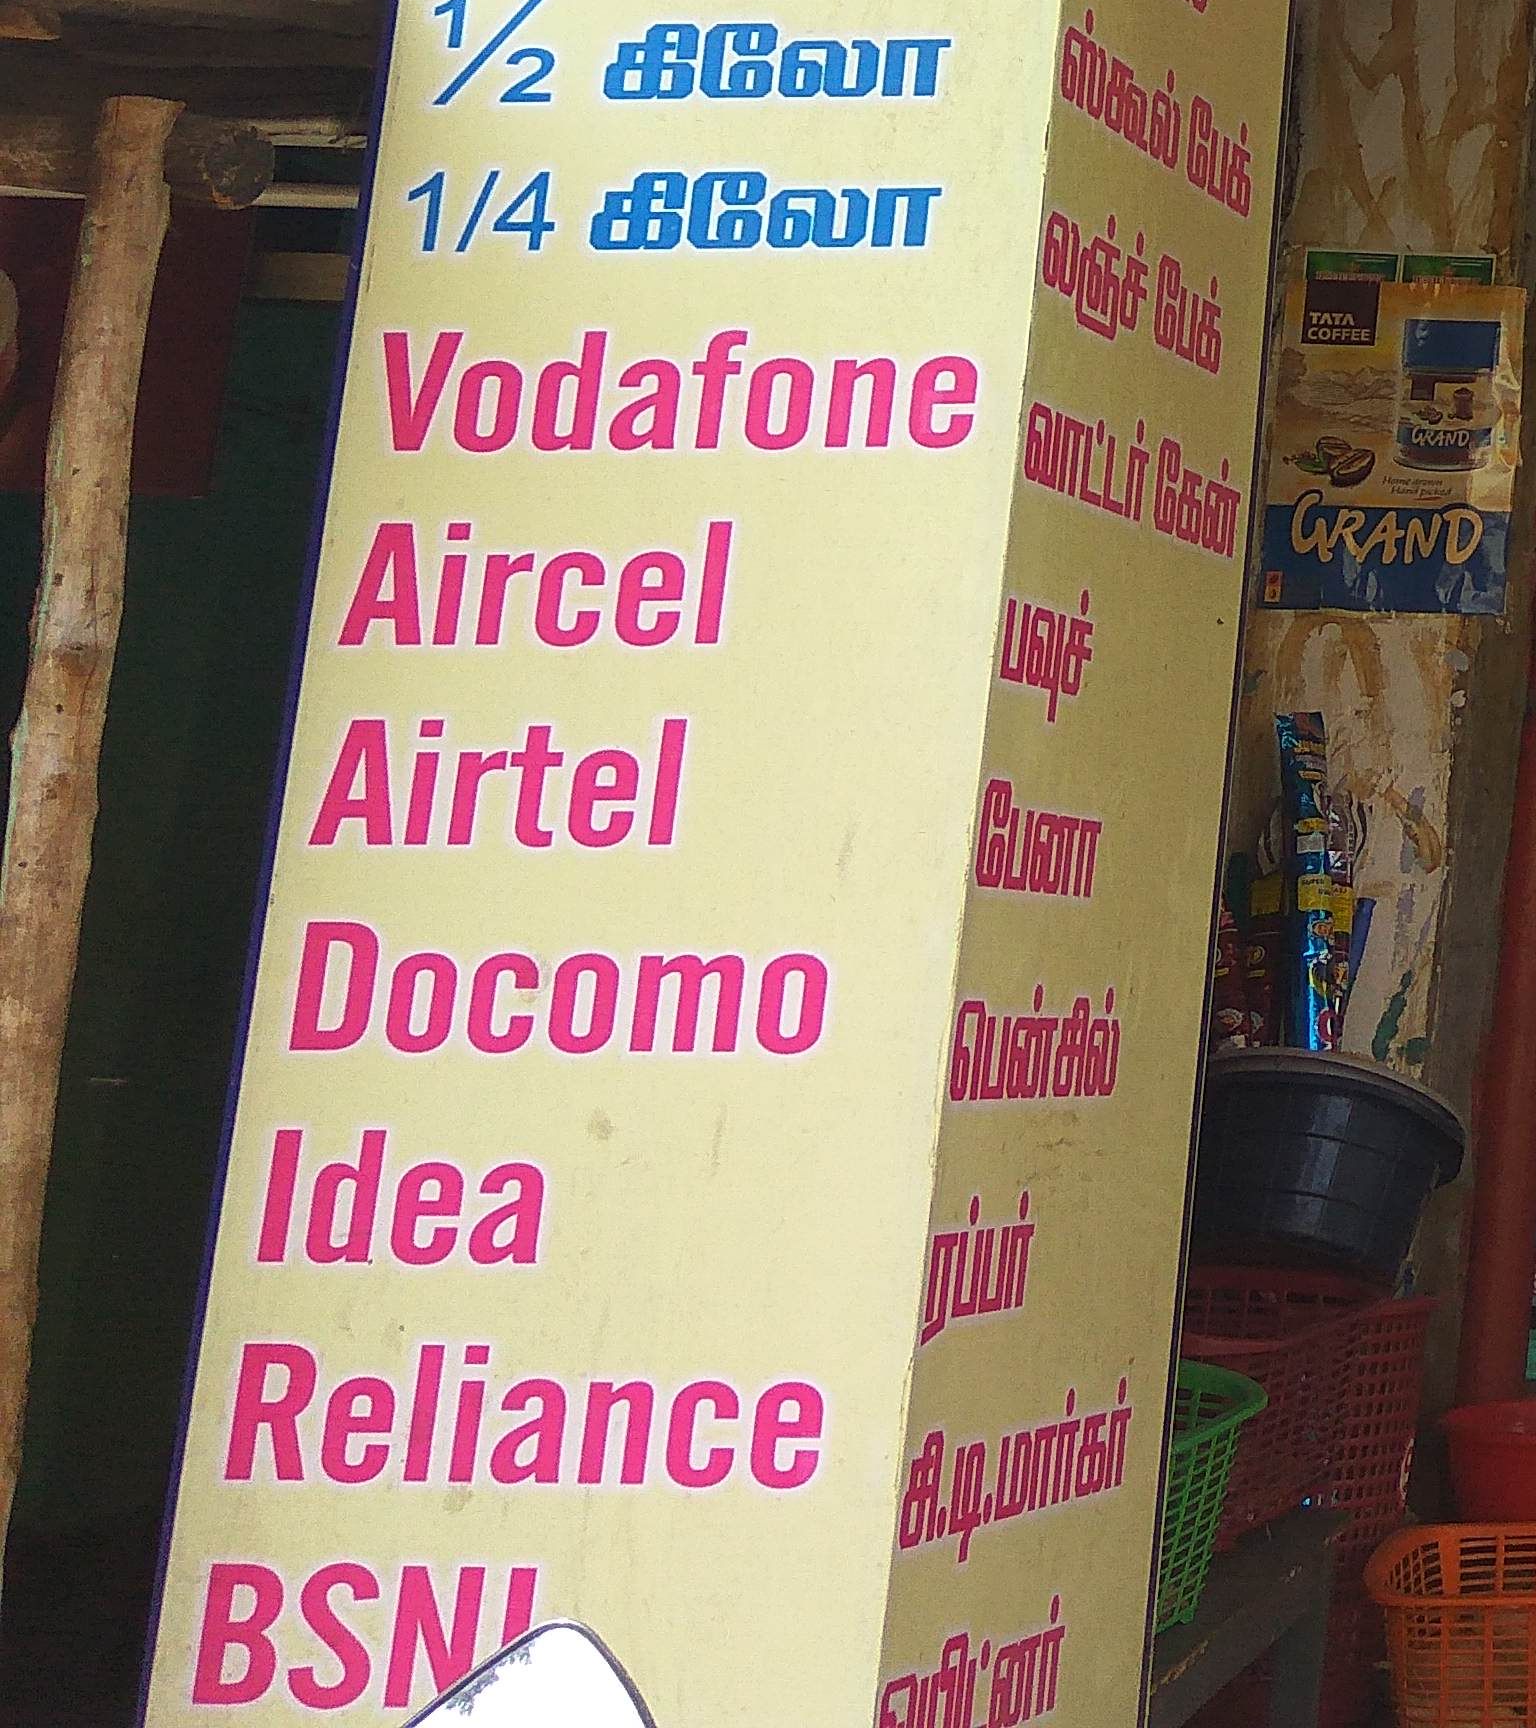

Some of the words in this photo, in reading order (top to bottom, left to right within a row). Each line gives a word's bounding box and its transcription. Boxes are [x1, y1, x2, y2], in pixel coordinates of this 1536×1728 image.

[602, 22, 952, 100] கிலோ
[1060, 8, 1182, 171] ஸ்கூல்
[1186, 95, 1252, 218] பேக்
[406, 169, 556, 253] 1/4
[588, 170, 943, 252] கிலோ
[1043, 210, 1149, 341] லஞ்ச்
[1153, 254, 1223, 375] பேக்
[1307, 328, 1372, 342] COFFEE
[1309, 311, 1355, 326] TATA
[382, 329, 979, 453] Vodafone
[1411, 425, 1470, 448] GRAND
[1024, 401, 1149, 523] வாட்டர்
[1154, 435, 1241, 559] கேன்
[1290, 488, 1485, 567] GRAND
[337, 520, 735, 648] Aircel
[999, 587, 1094, 723] பவுச்
[307, 717, 689, 849] Airtel
[975, 779, 1103, 898] பேனா
[288, 920, 828, 1056] Docomo
[949, 983, 1121, 1102] பென்சில்
[256, 1128, 546, 1265] Idea
[920, 1190, 1035, 1347] ரப்பர்
[223, 1342, 827, 1491] Reliance
